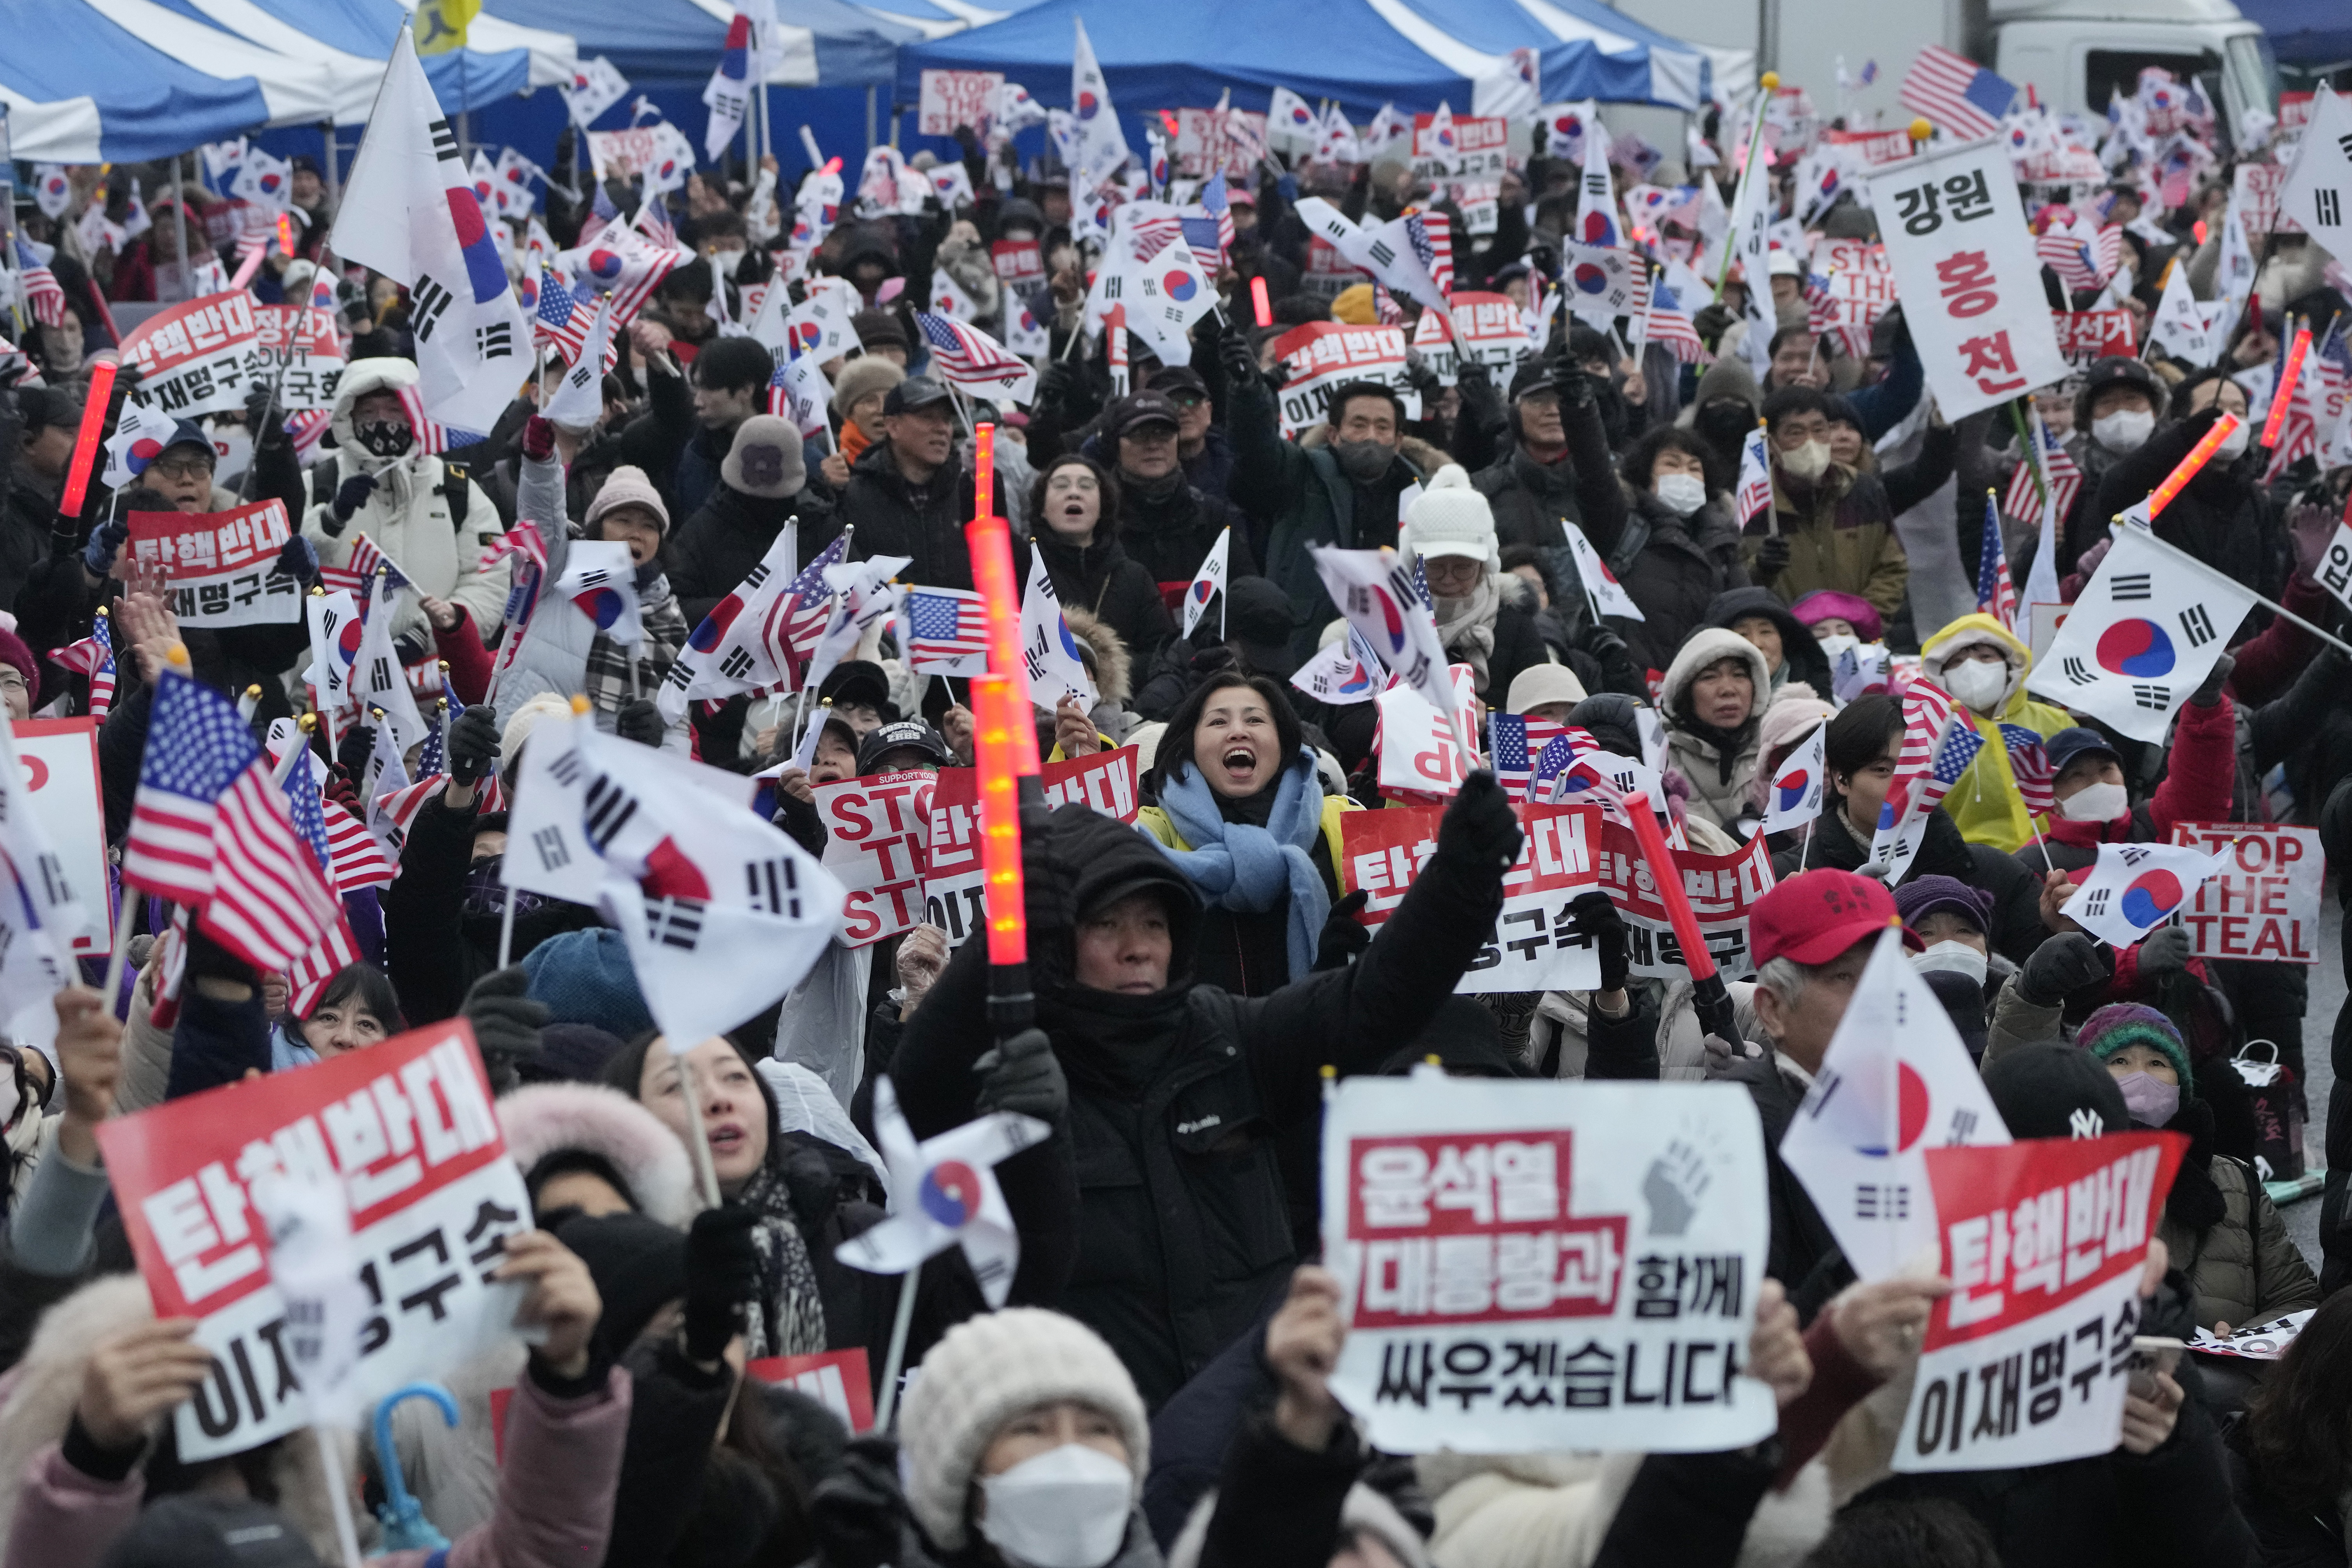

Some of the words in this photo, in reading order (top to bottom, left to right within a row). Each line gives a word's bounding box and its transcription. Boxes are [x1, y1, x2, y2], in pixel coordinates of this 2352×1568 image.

[1894, 168, 1994, 236] 강원
[1831, 246, 1891, 274] STO
[123, 295, 255, 374] 탄핵반대
[253, 308, 340, 347] 정선거
[1935, 250, 2029, 395] 홍천
[2052, 312, 2133, 347] 정선거
[1286, 329, 1407, 381] 탄핵반대
[135, 504, 290, 574] 탄핵반대
[165, 573, 296, 618] 재명구속
[879, 772, 918, 784] SUPPORT
[919, 771, 936, 781] YOON
[831, 783, 938, 842] STO
[2185, 833, 2303, 874] TOP
[2185, 915, 2310, 959] TEAL
[1360, 1142, 1558, 1226] 윤석열
[1947, 1145, 2161, 1329] 탄핵반대
[1366, 1226, 1621, 1315] 대통령과
[1631, 1254, 1744, 1319] 함께
[1375, 1340, 1742, 1410] 싸우겠습니다
